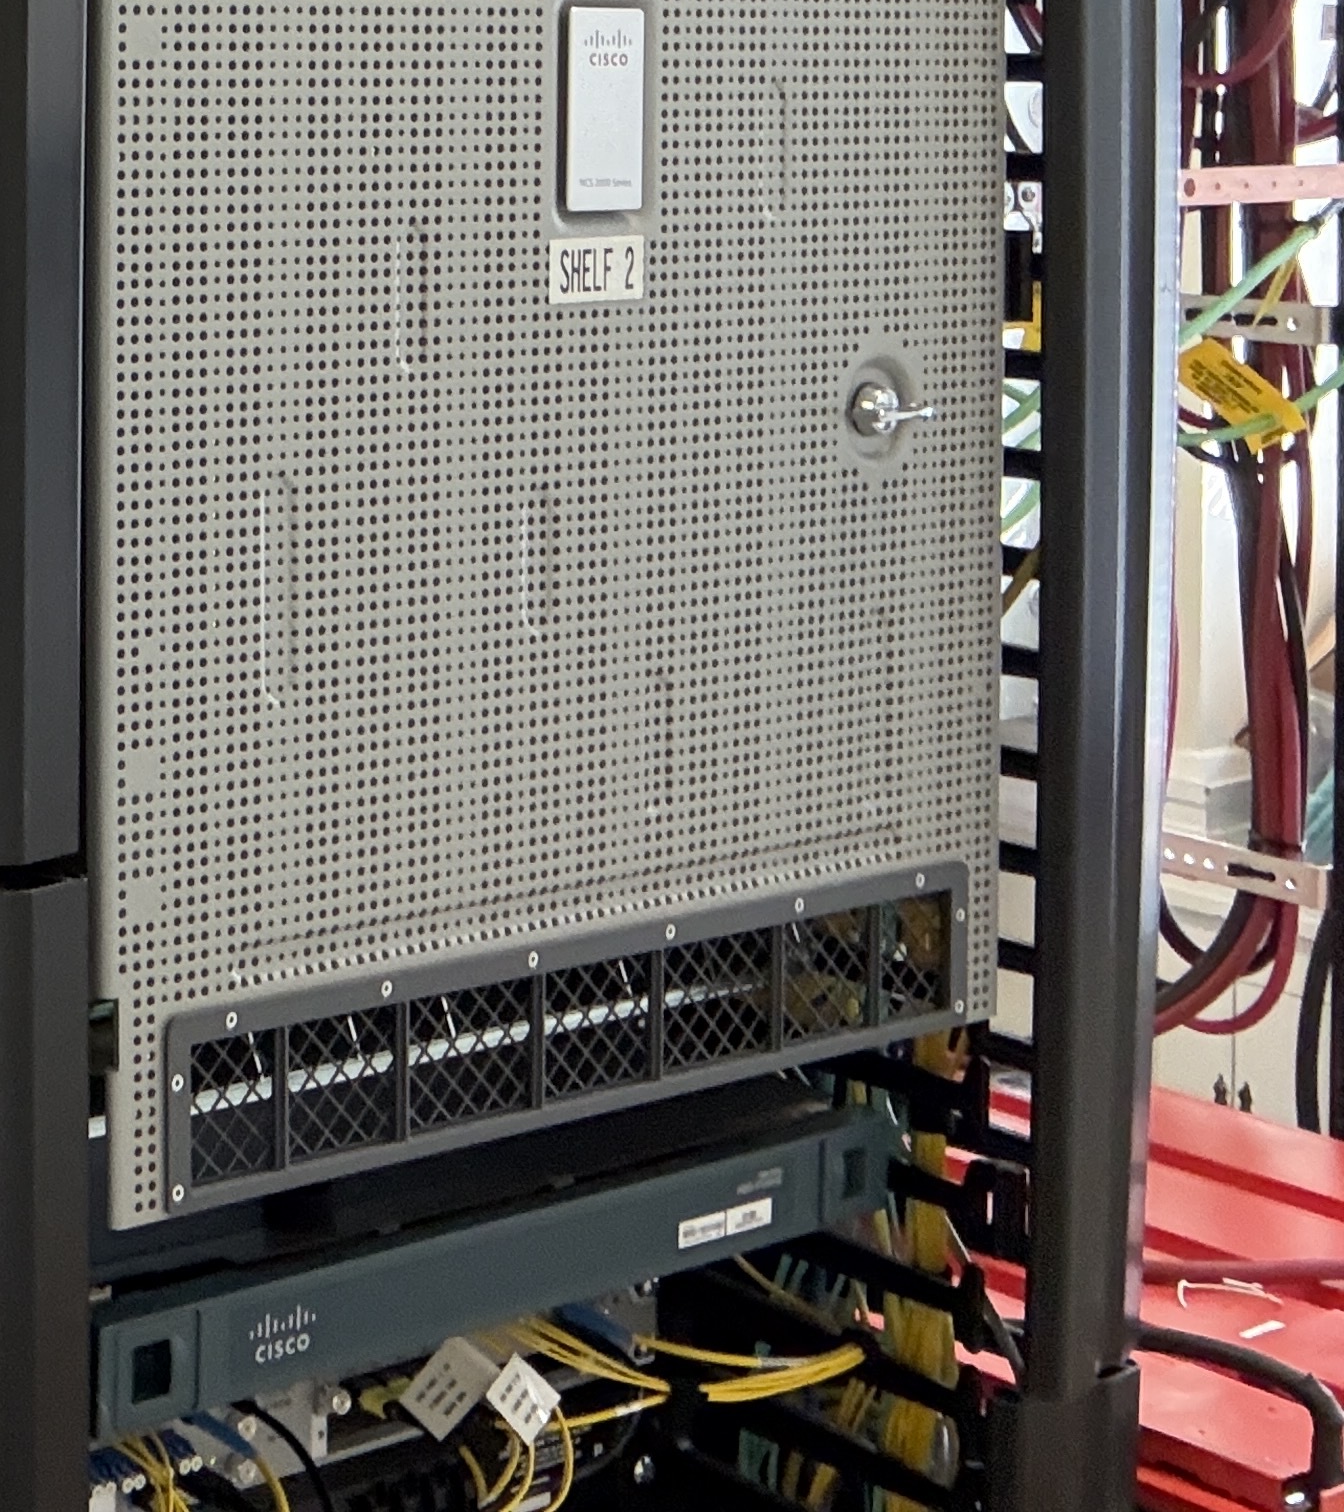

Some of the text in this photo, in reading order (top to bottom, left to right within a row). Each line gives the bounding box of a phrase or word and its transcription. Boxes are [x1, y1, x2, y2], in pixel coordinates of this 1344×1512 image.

[589, 52, 629, 67] CISCO
[559, 245, 635, 295] SHELF 2
[255, 1332, 311, 1365] CISCO
